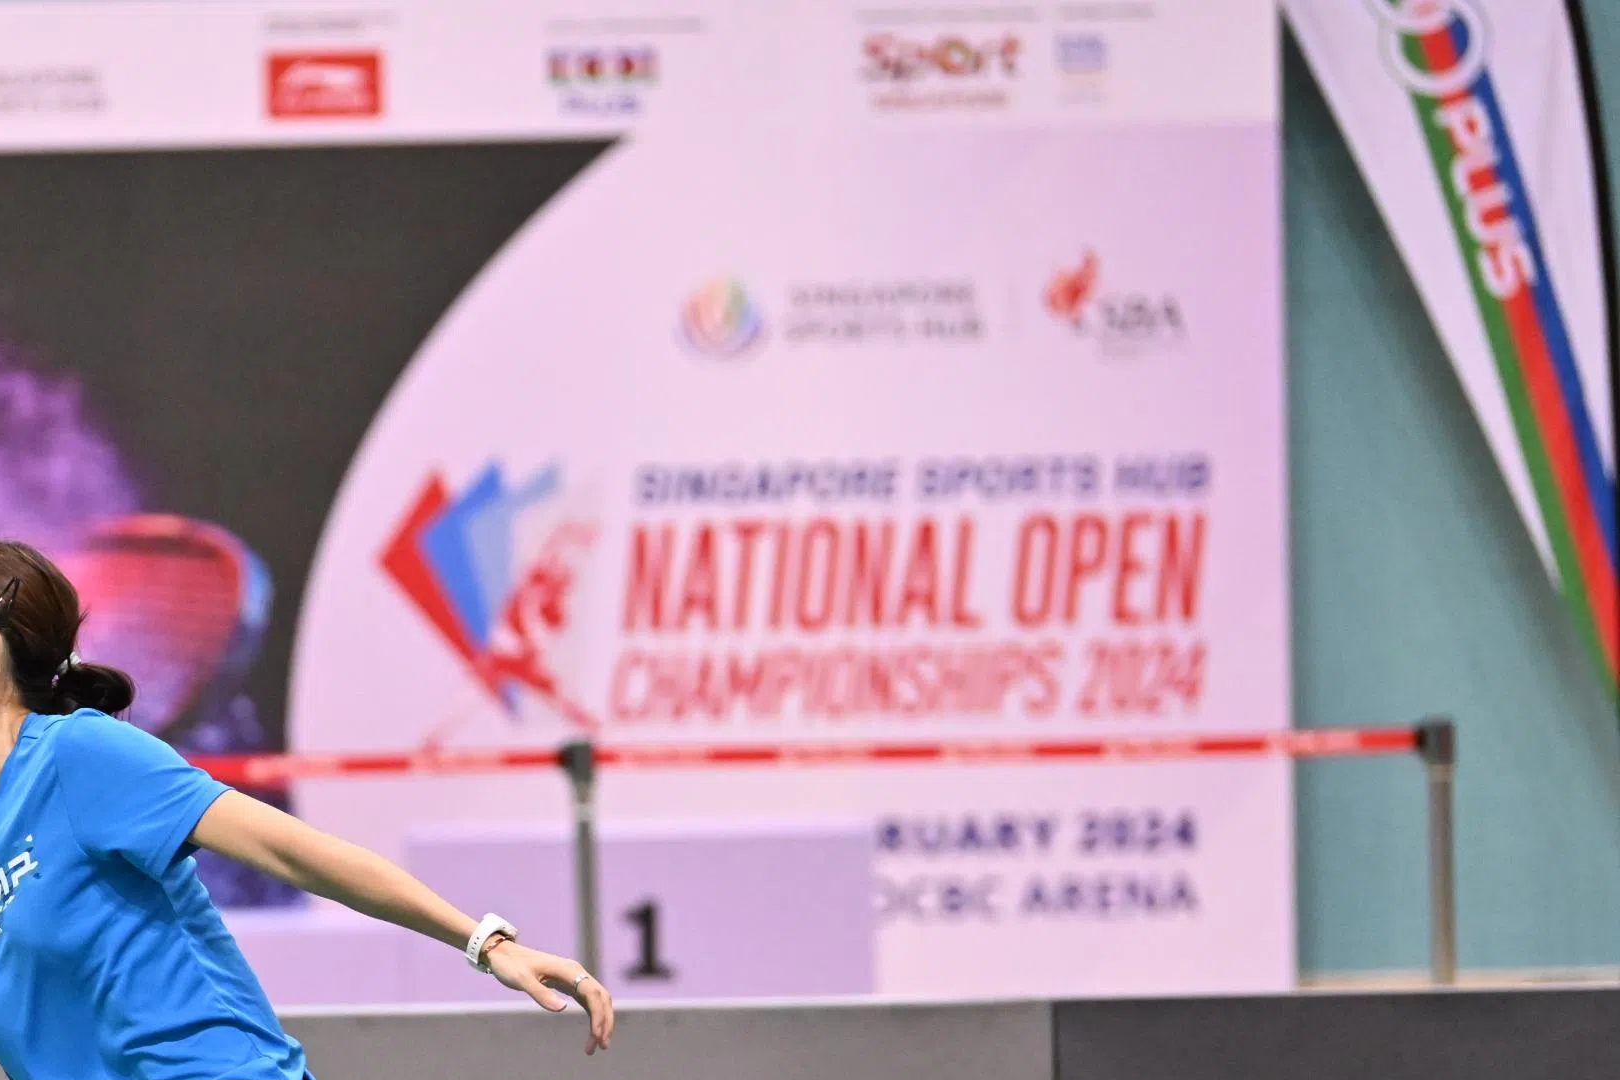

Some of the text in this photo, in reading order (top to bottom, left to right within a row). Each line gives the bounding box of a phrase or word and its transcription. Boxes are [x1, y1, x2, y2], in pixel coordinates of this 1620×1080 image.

[636, 453, 1211, 502] SINGAPORE SPORTS HUB
[620, 512, 1208, 633] NATIONAL OPEN
[608, 638, 1208, 721] CHAMPIONSHIPS 2024
[1077, 807, 1197, 852] 2024
[1021, 869, 1202, 915] ARENA
[621, 900, 677, 982] 1
